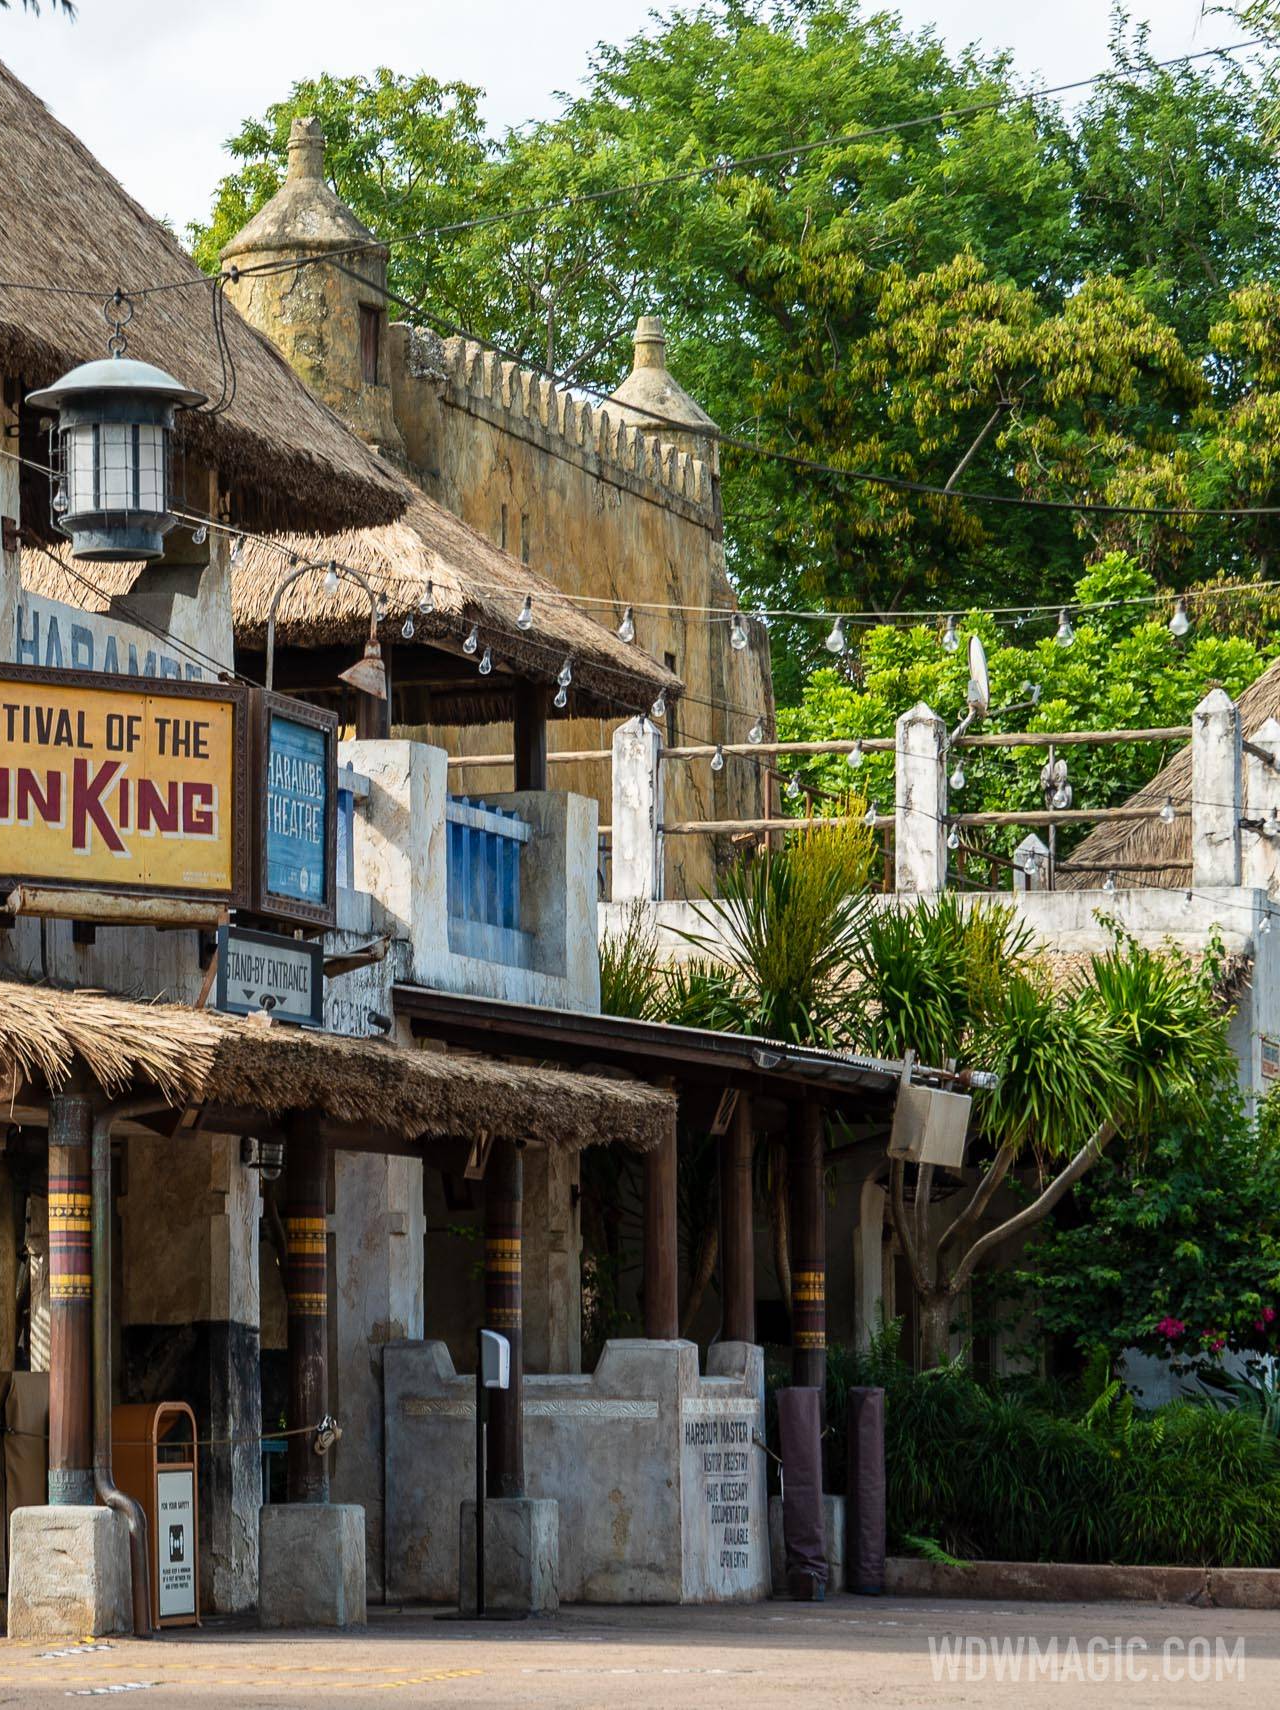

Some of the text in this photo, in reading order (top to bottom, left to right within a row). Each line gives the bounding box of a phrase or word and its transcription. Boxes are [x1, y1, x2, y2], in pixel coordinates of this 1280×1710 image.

[105, 713, 142, 753] OF
[154, 717, 210, 759] THE
[267, 752, 323, 800] HARAMBE
[72, 758, 218, 858] KING
[267, 792, 321, 845] THEATRE
[267, 959, 308, 993] ENTRANCE
[685, 1421, 748, 1446] HARBOUR MASTER
[723, 1452, 748, 1471] REGISTRY
[720, 1482, 748, 1502] NECESSARY
[711, 1504, 749, 1524] DOCUMENTATION
[724, 1527, 748, 1545] AVAILABLE
[734, 1551, 748, 1568] ENTRY
